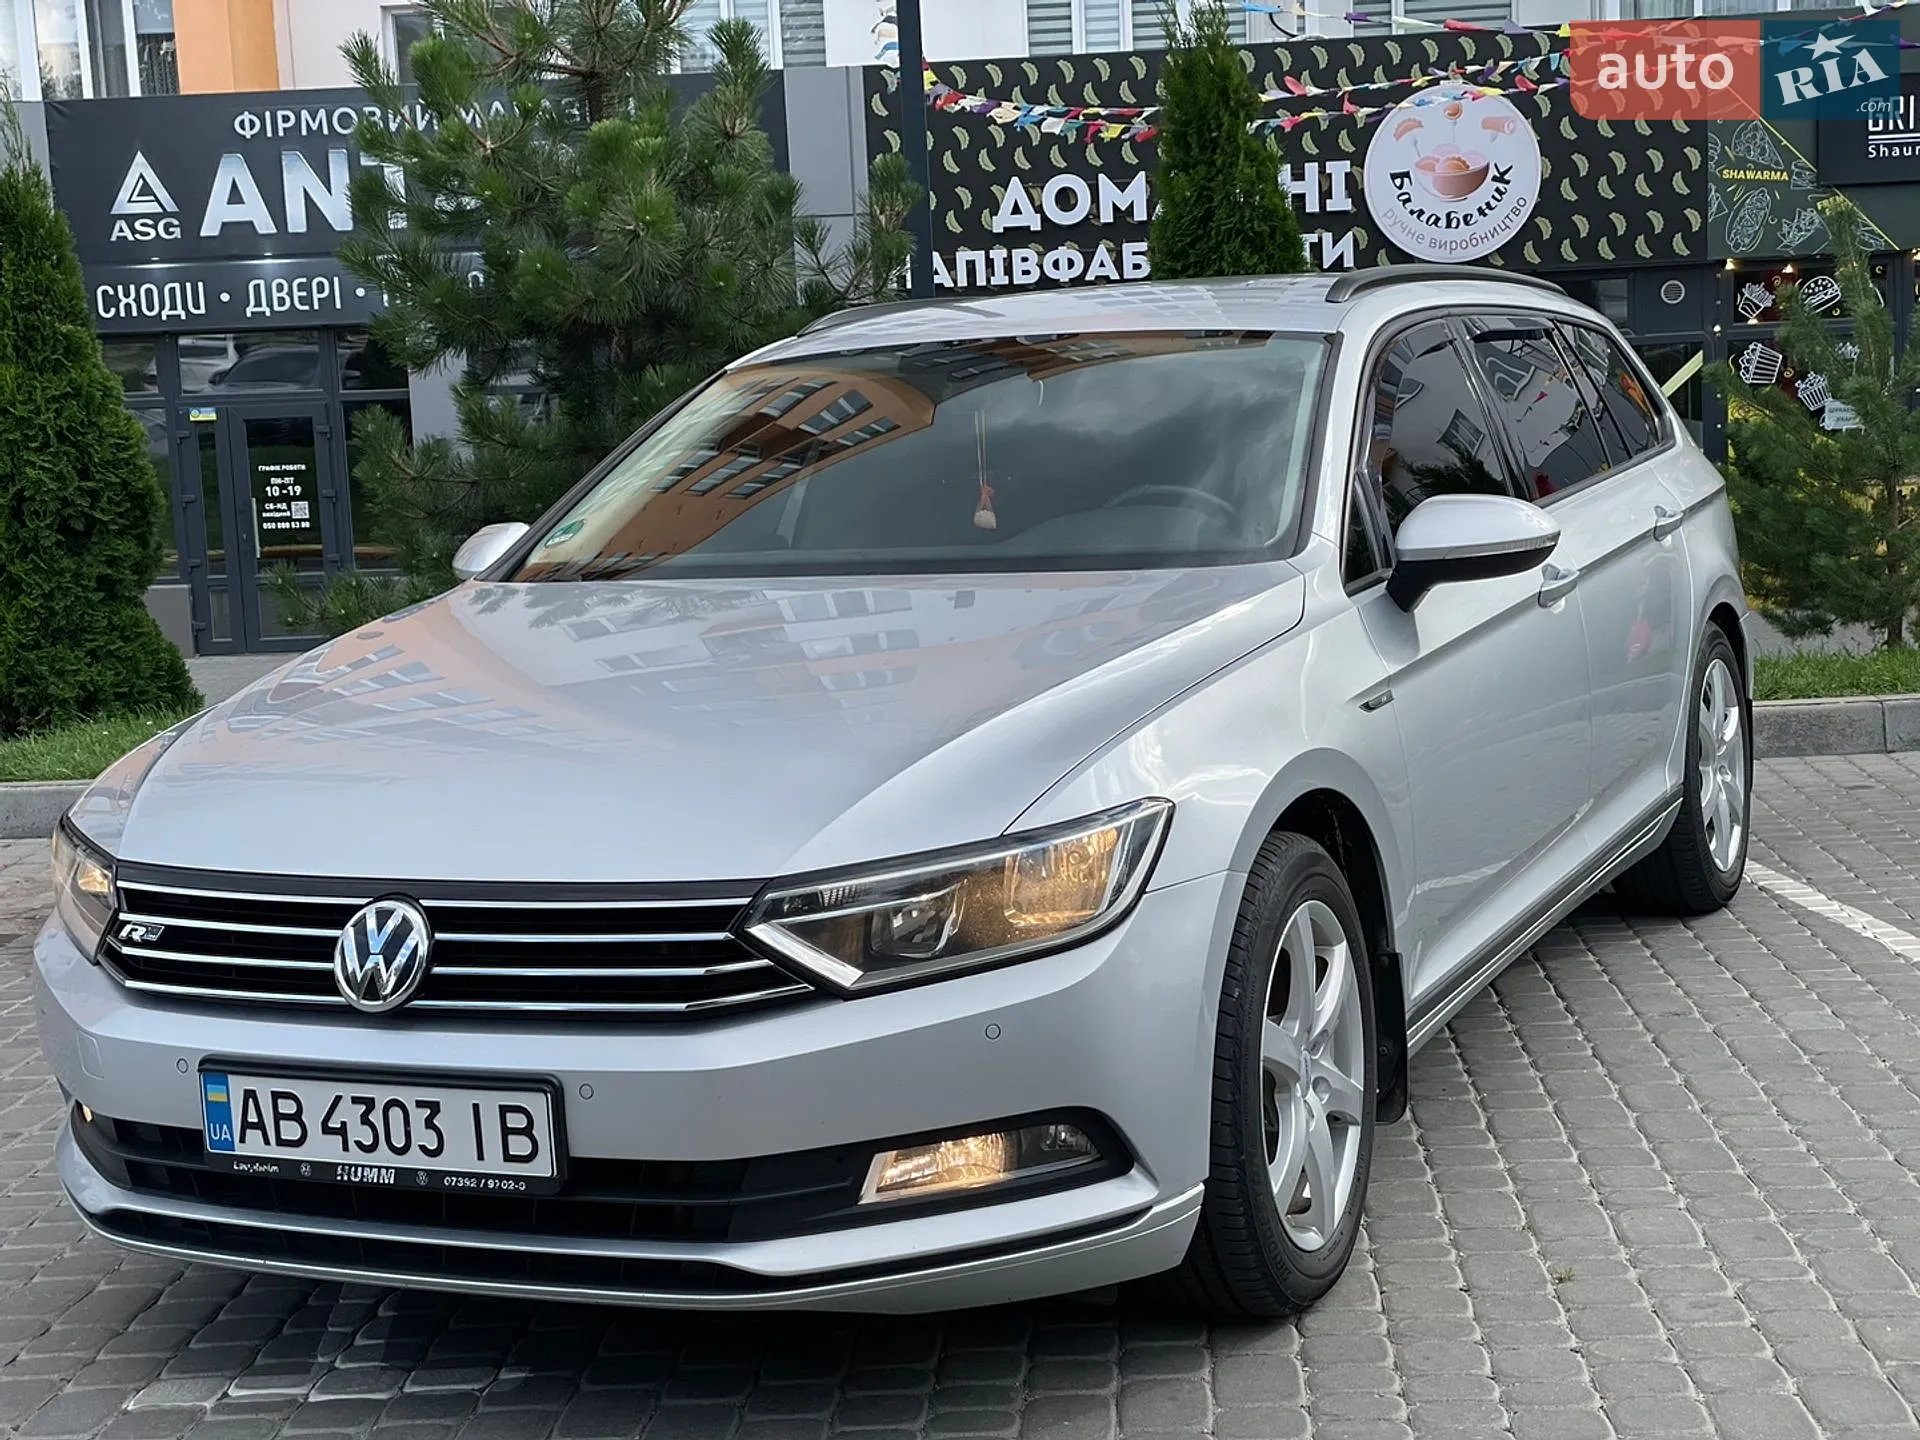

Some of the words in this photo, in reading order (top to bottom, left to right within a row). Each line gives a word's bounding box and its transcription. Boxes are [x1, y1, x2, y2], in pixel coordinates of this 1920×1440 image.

[1722, 168, 1790, 182] SHAWARMA
[110, 217, 182, 242] ASG
[1381, 208, 1426, 245] ручне
[1427, 197, 1528, 255] виробництво
[245, 275, 342, 318] ДВЕРІ
[209, 1123, 232, 1142] UA
[238, 1087, 309, 1149] AB
[320, 1094, 446, 1159] 4303
[471, 1101, 540, 1164] IB
[336, 1164, 396, 1184] HUMM
